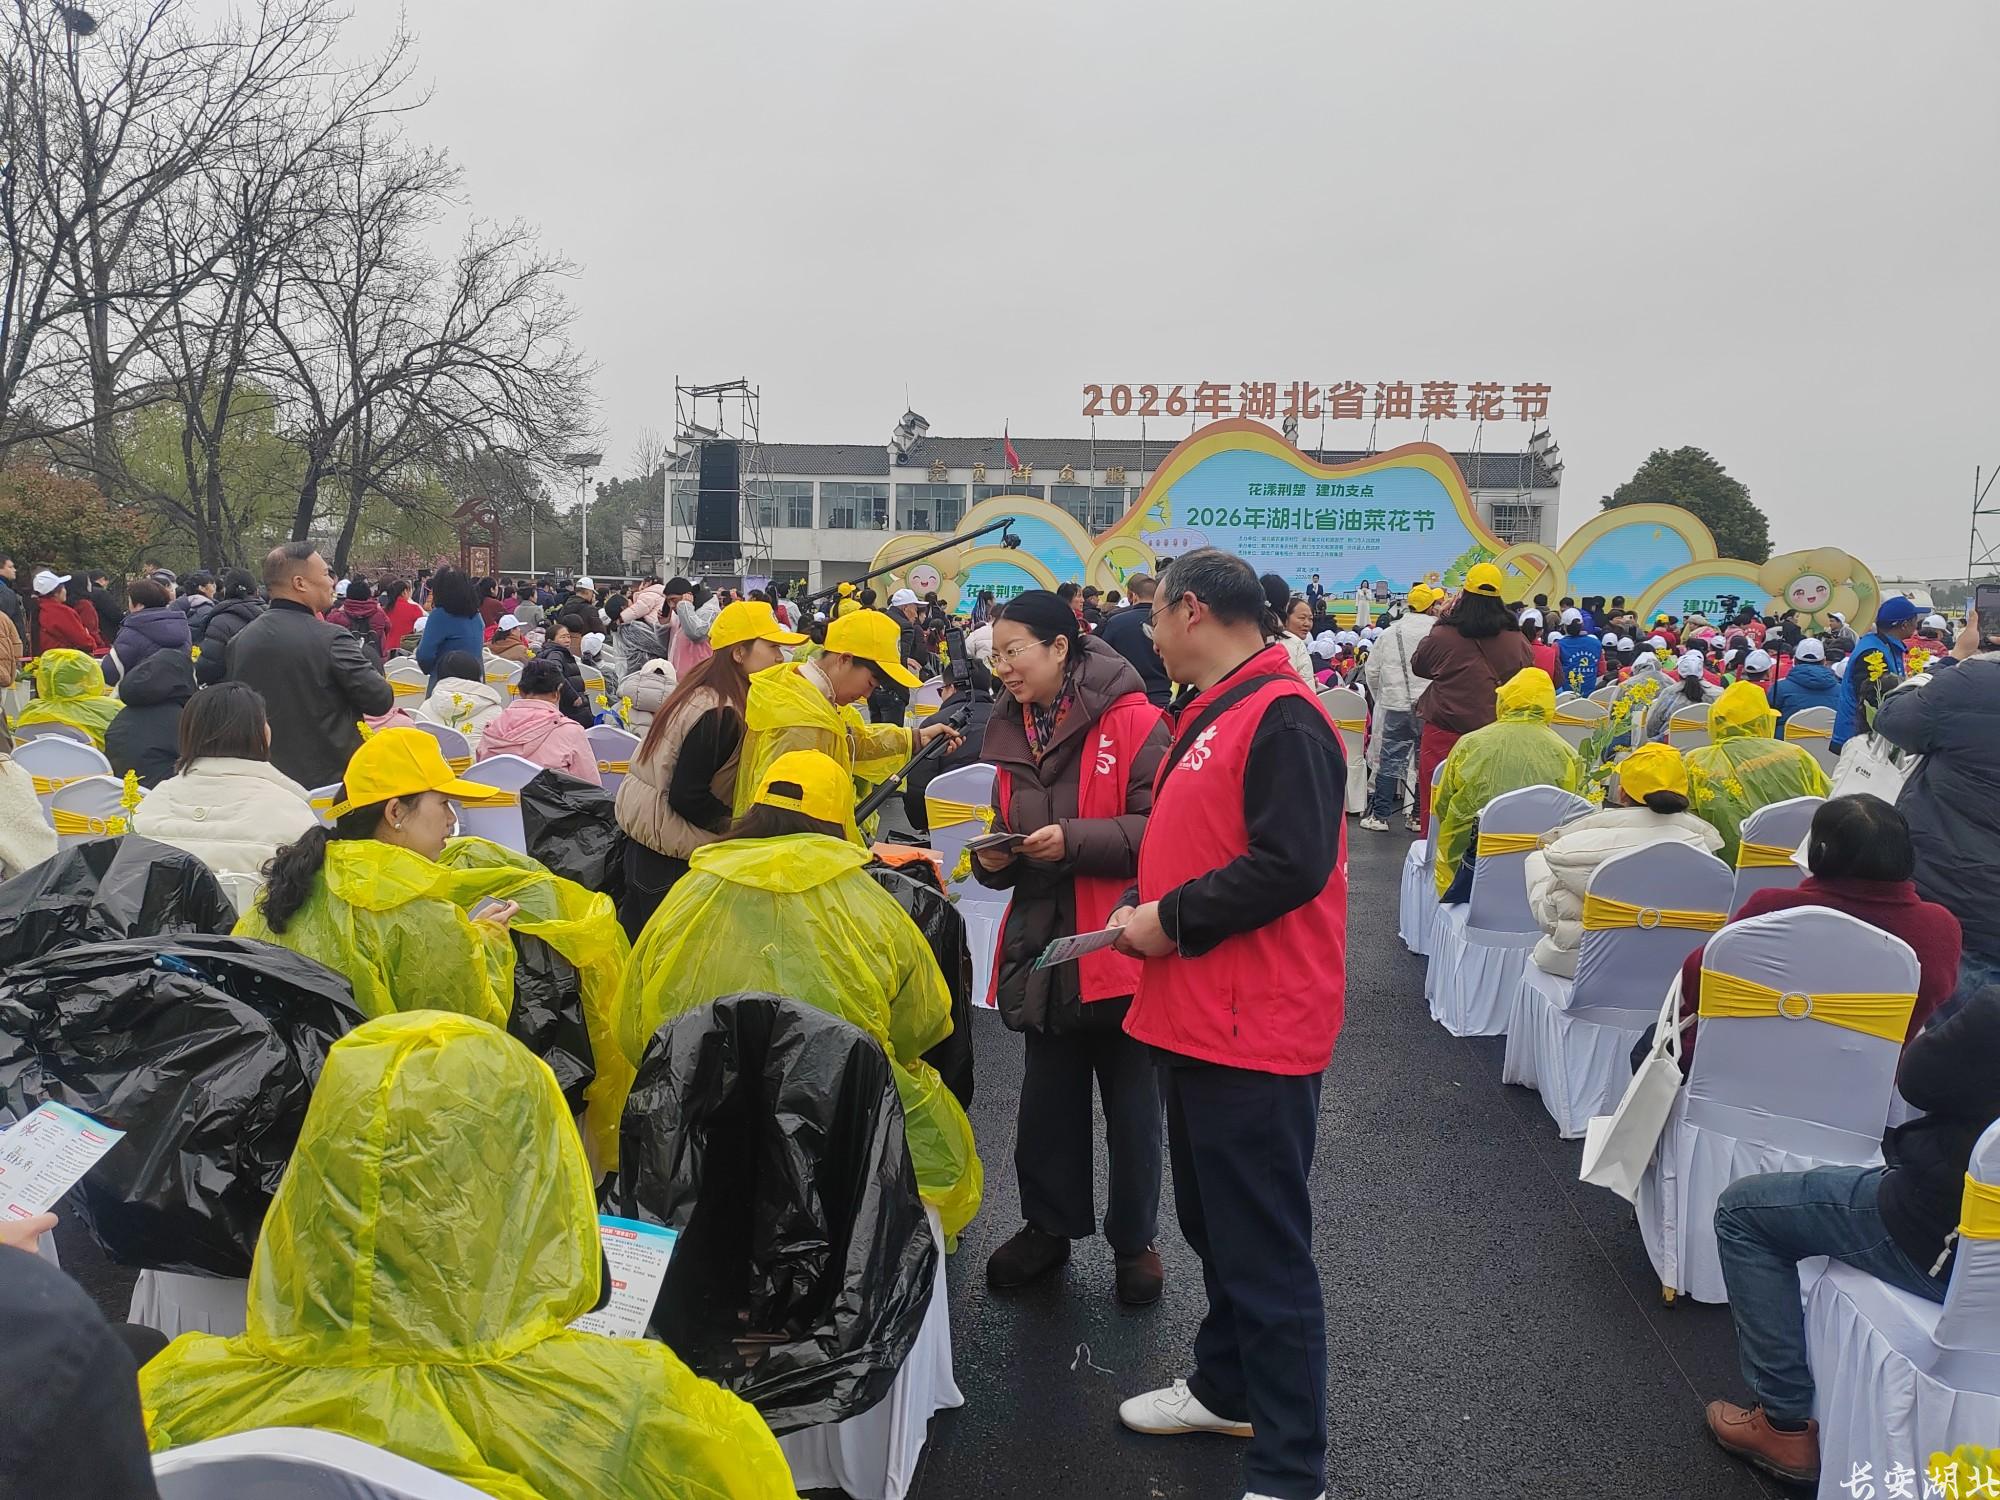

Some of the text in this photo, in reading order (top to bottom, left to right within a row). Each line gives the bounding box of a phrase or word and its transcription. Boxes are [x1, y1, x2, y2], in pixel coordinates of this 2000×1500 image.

[1082, 380, 1551, 422] 2026年湖北省油菜花节
[1248, 482, 1375, 498] 花漾荆楚 建功支点
[1186, 507, 1435, 532] 2026年湖北省油菜花节
[1683, 600, 1756, 614] 建功点
